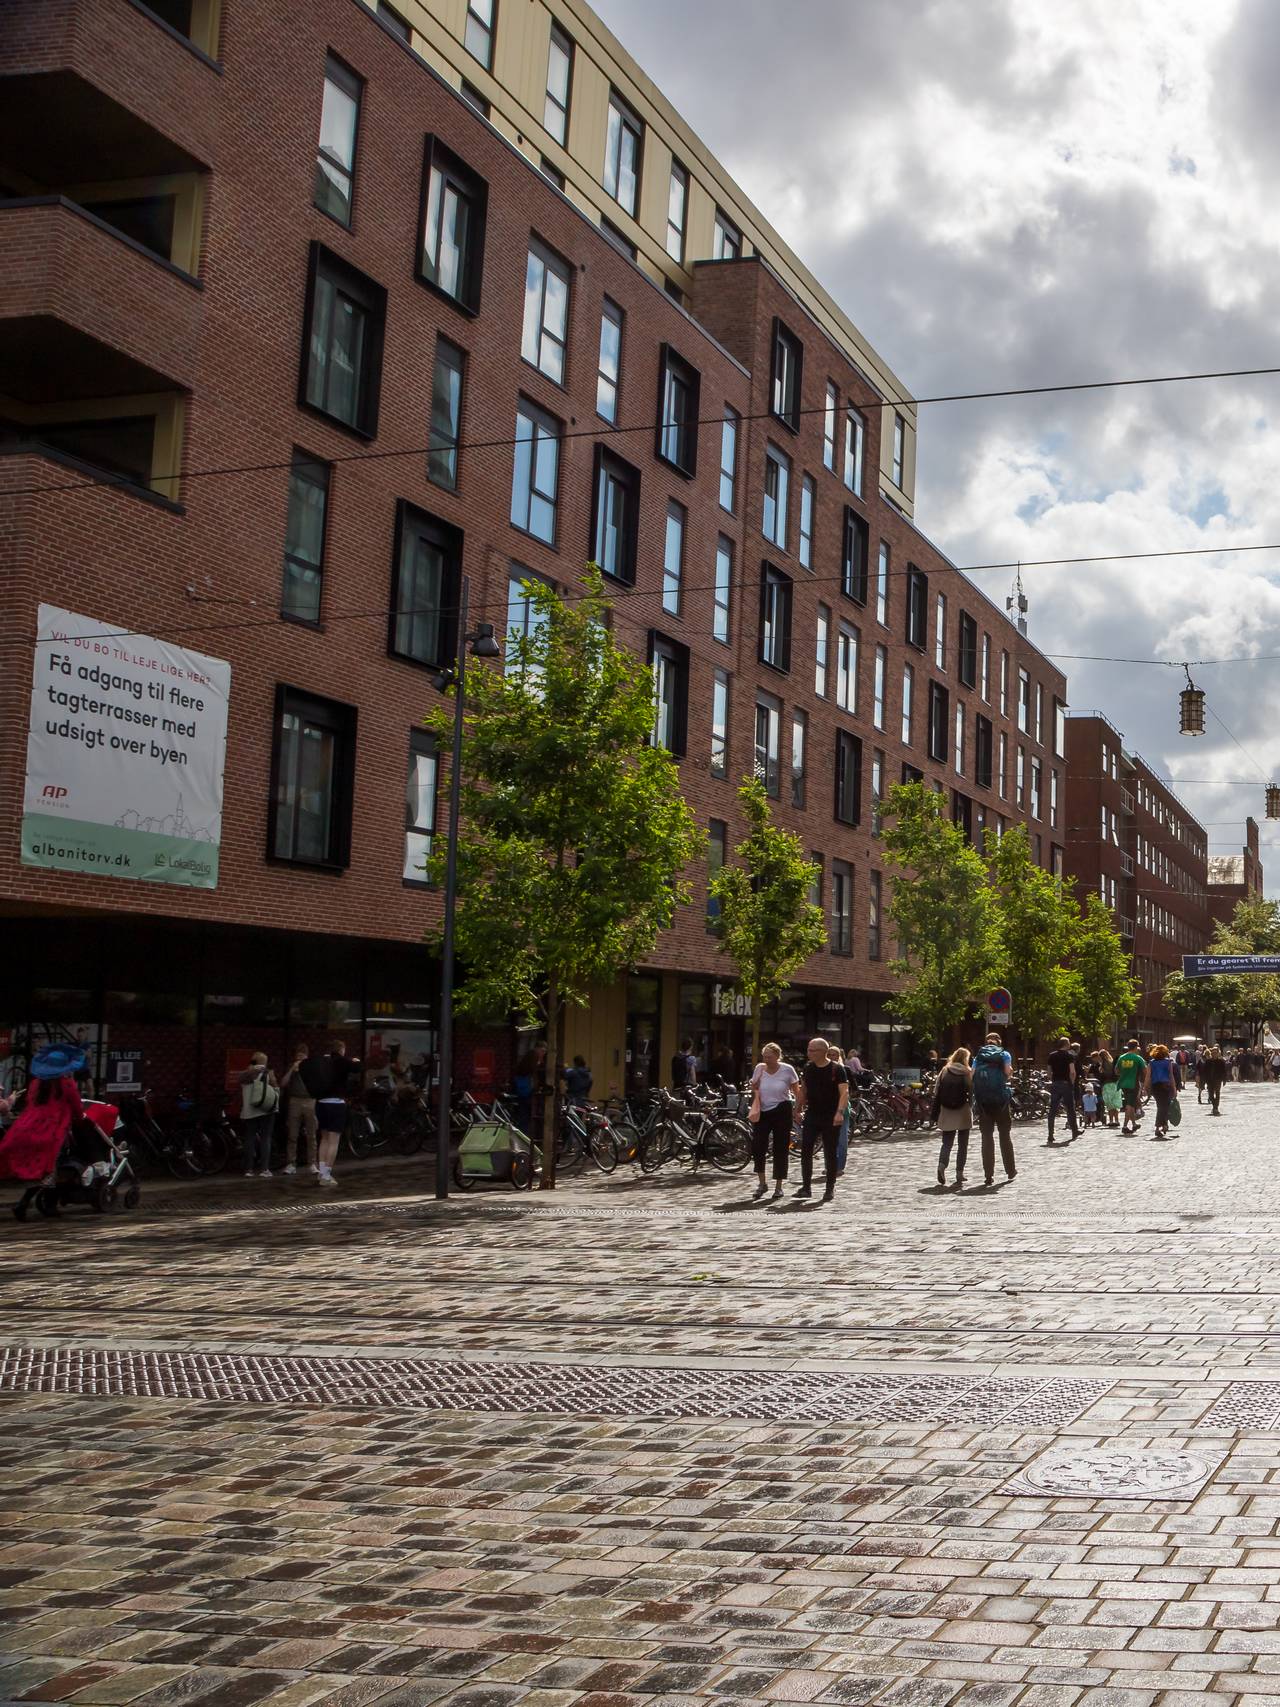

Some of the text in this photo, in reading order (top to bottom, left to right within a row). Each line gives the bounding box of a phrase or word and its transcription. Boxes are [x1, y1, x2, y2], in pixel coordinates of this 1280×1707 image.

[51, 630, 69, 644] VIL
[74, 638, 90, 649] DU
[94, 643, 109, 655] BO
[113, 648, 129, 661] TIL
[133, 654, 157, 670] LEJE
[161, 663, 183, 677] LIGE
[50, 653, 204, 712] Få adgang til flere
[48, 685, 196, 738] tagterrasser med
[46, 719, 188, 765] udsigt over byen
[42, 785, 68, 799] AP
[32, 842, 131, 867] albanitorv.dk
[1221, 958, 1249, 966] gearet
